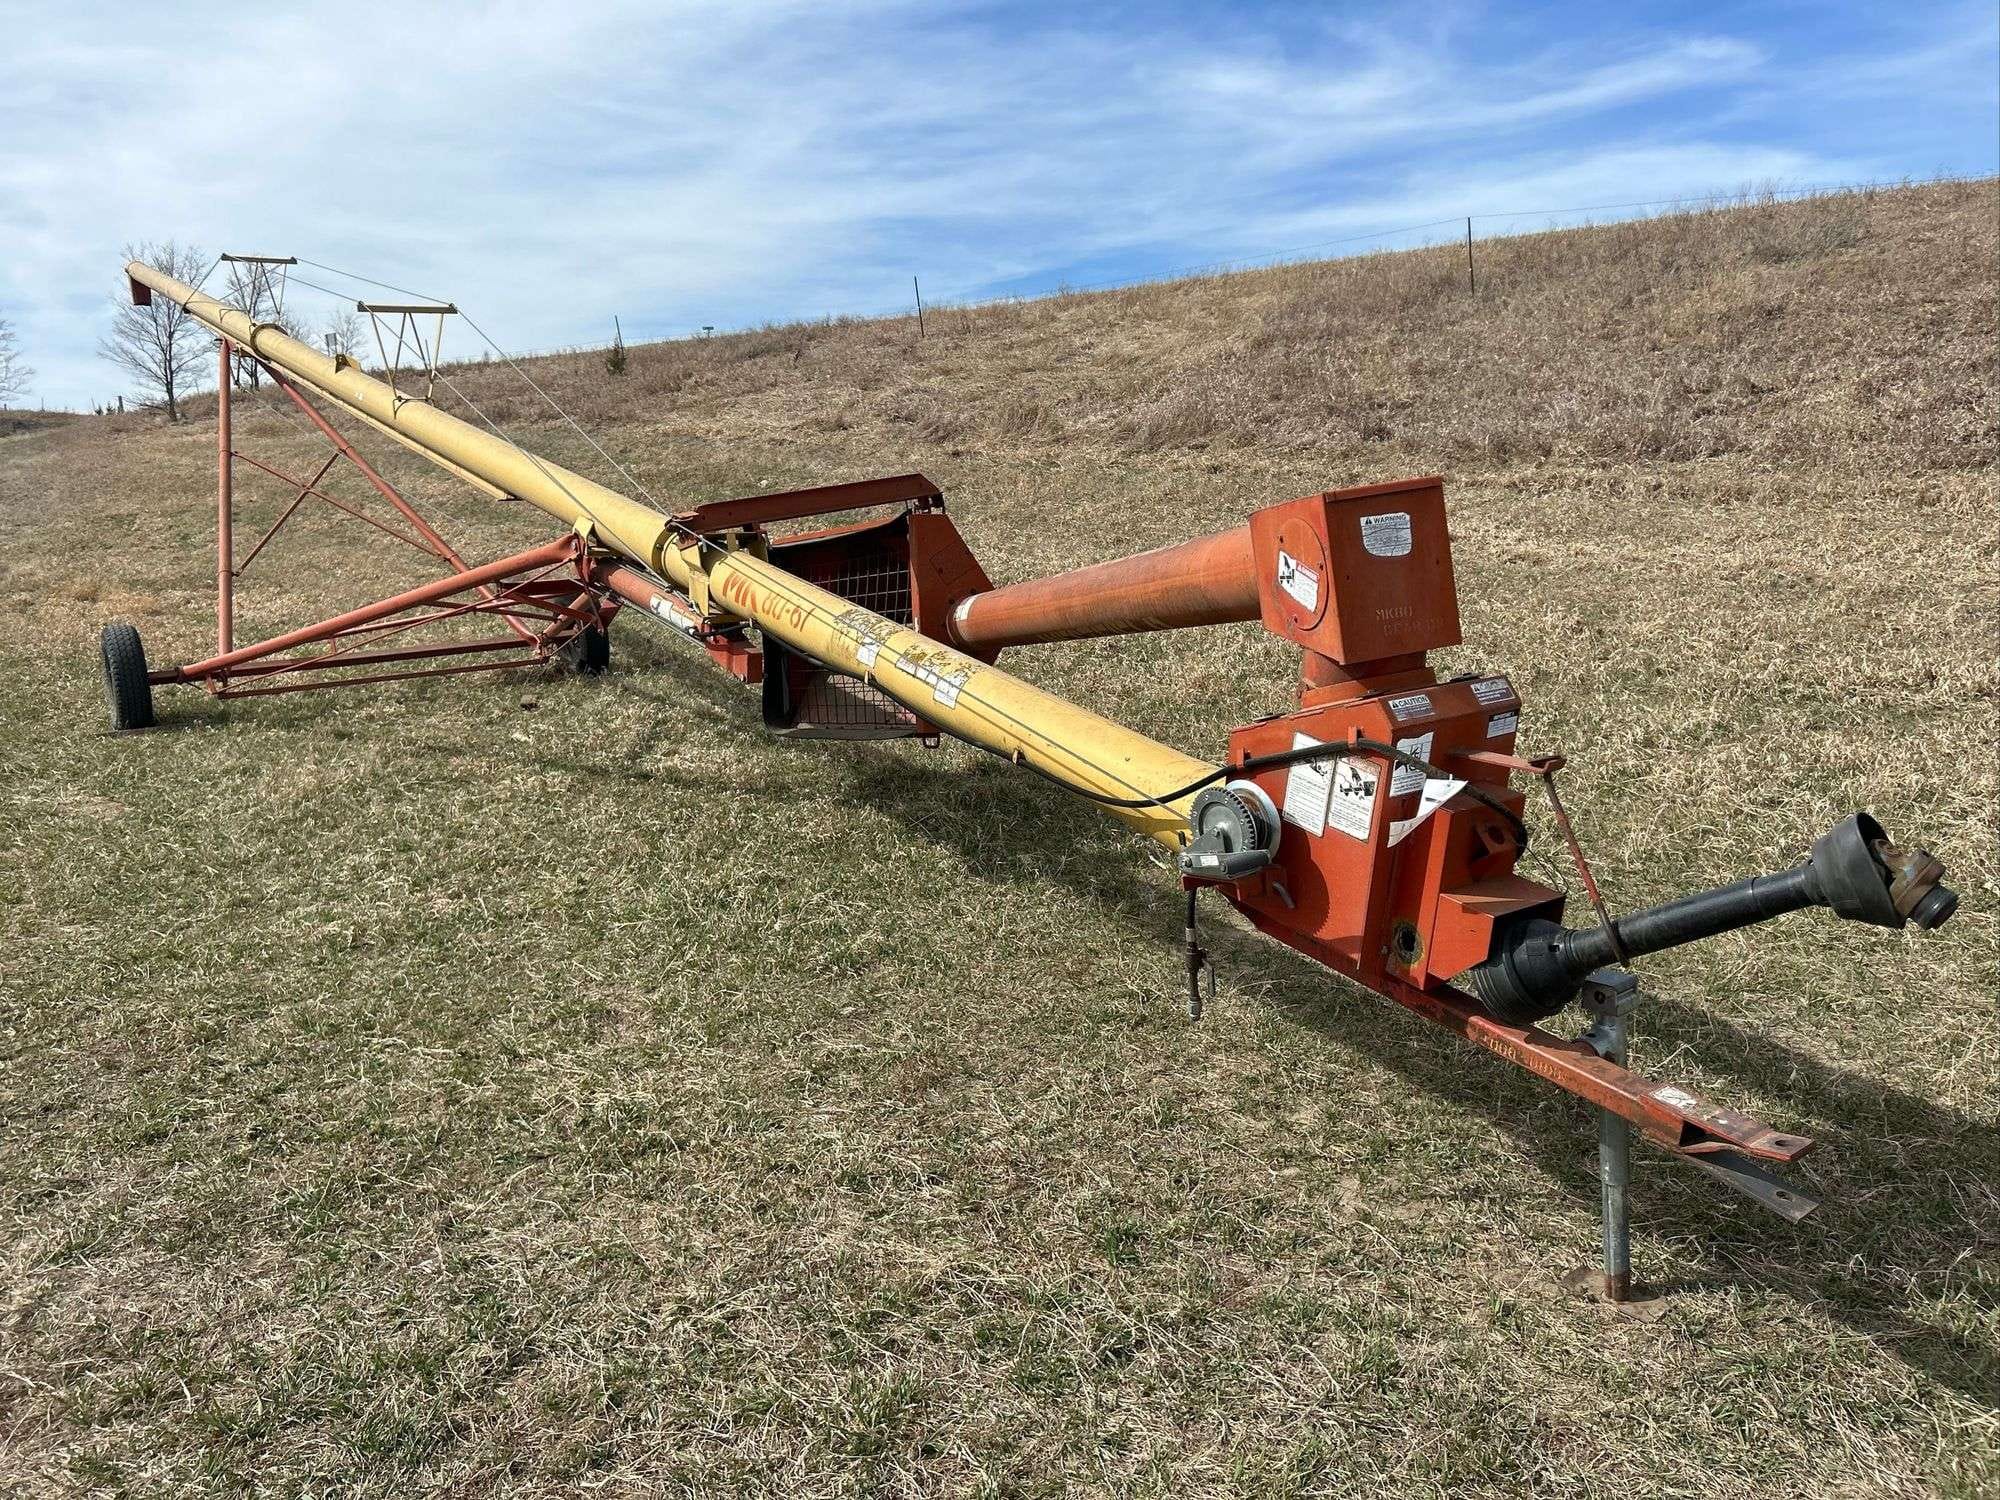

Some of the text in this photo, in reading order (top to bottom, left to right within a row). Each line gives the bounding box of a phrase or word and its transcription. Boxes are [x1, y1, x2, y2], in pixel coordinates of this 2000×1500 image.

[1373, 514, 1407, 524] WARNING
[722, 570, 758, 613] MK
[1399, 696, 1429, 708] CAUTION
